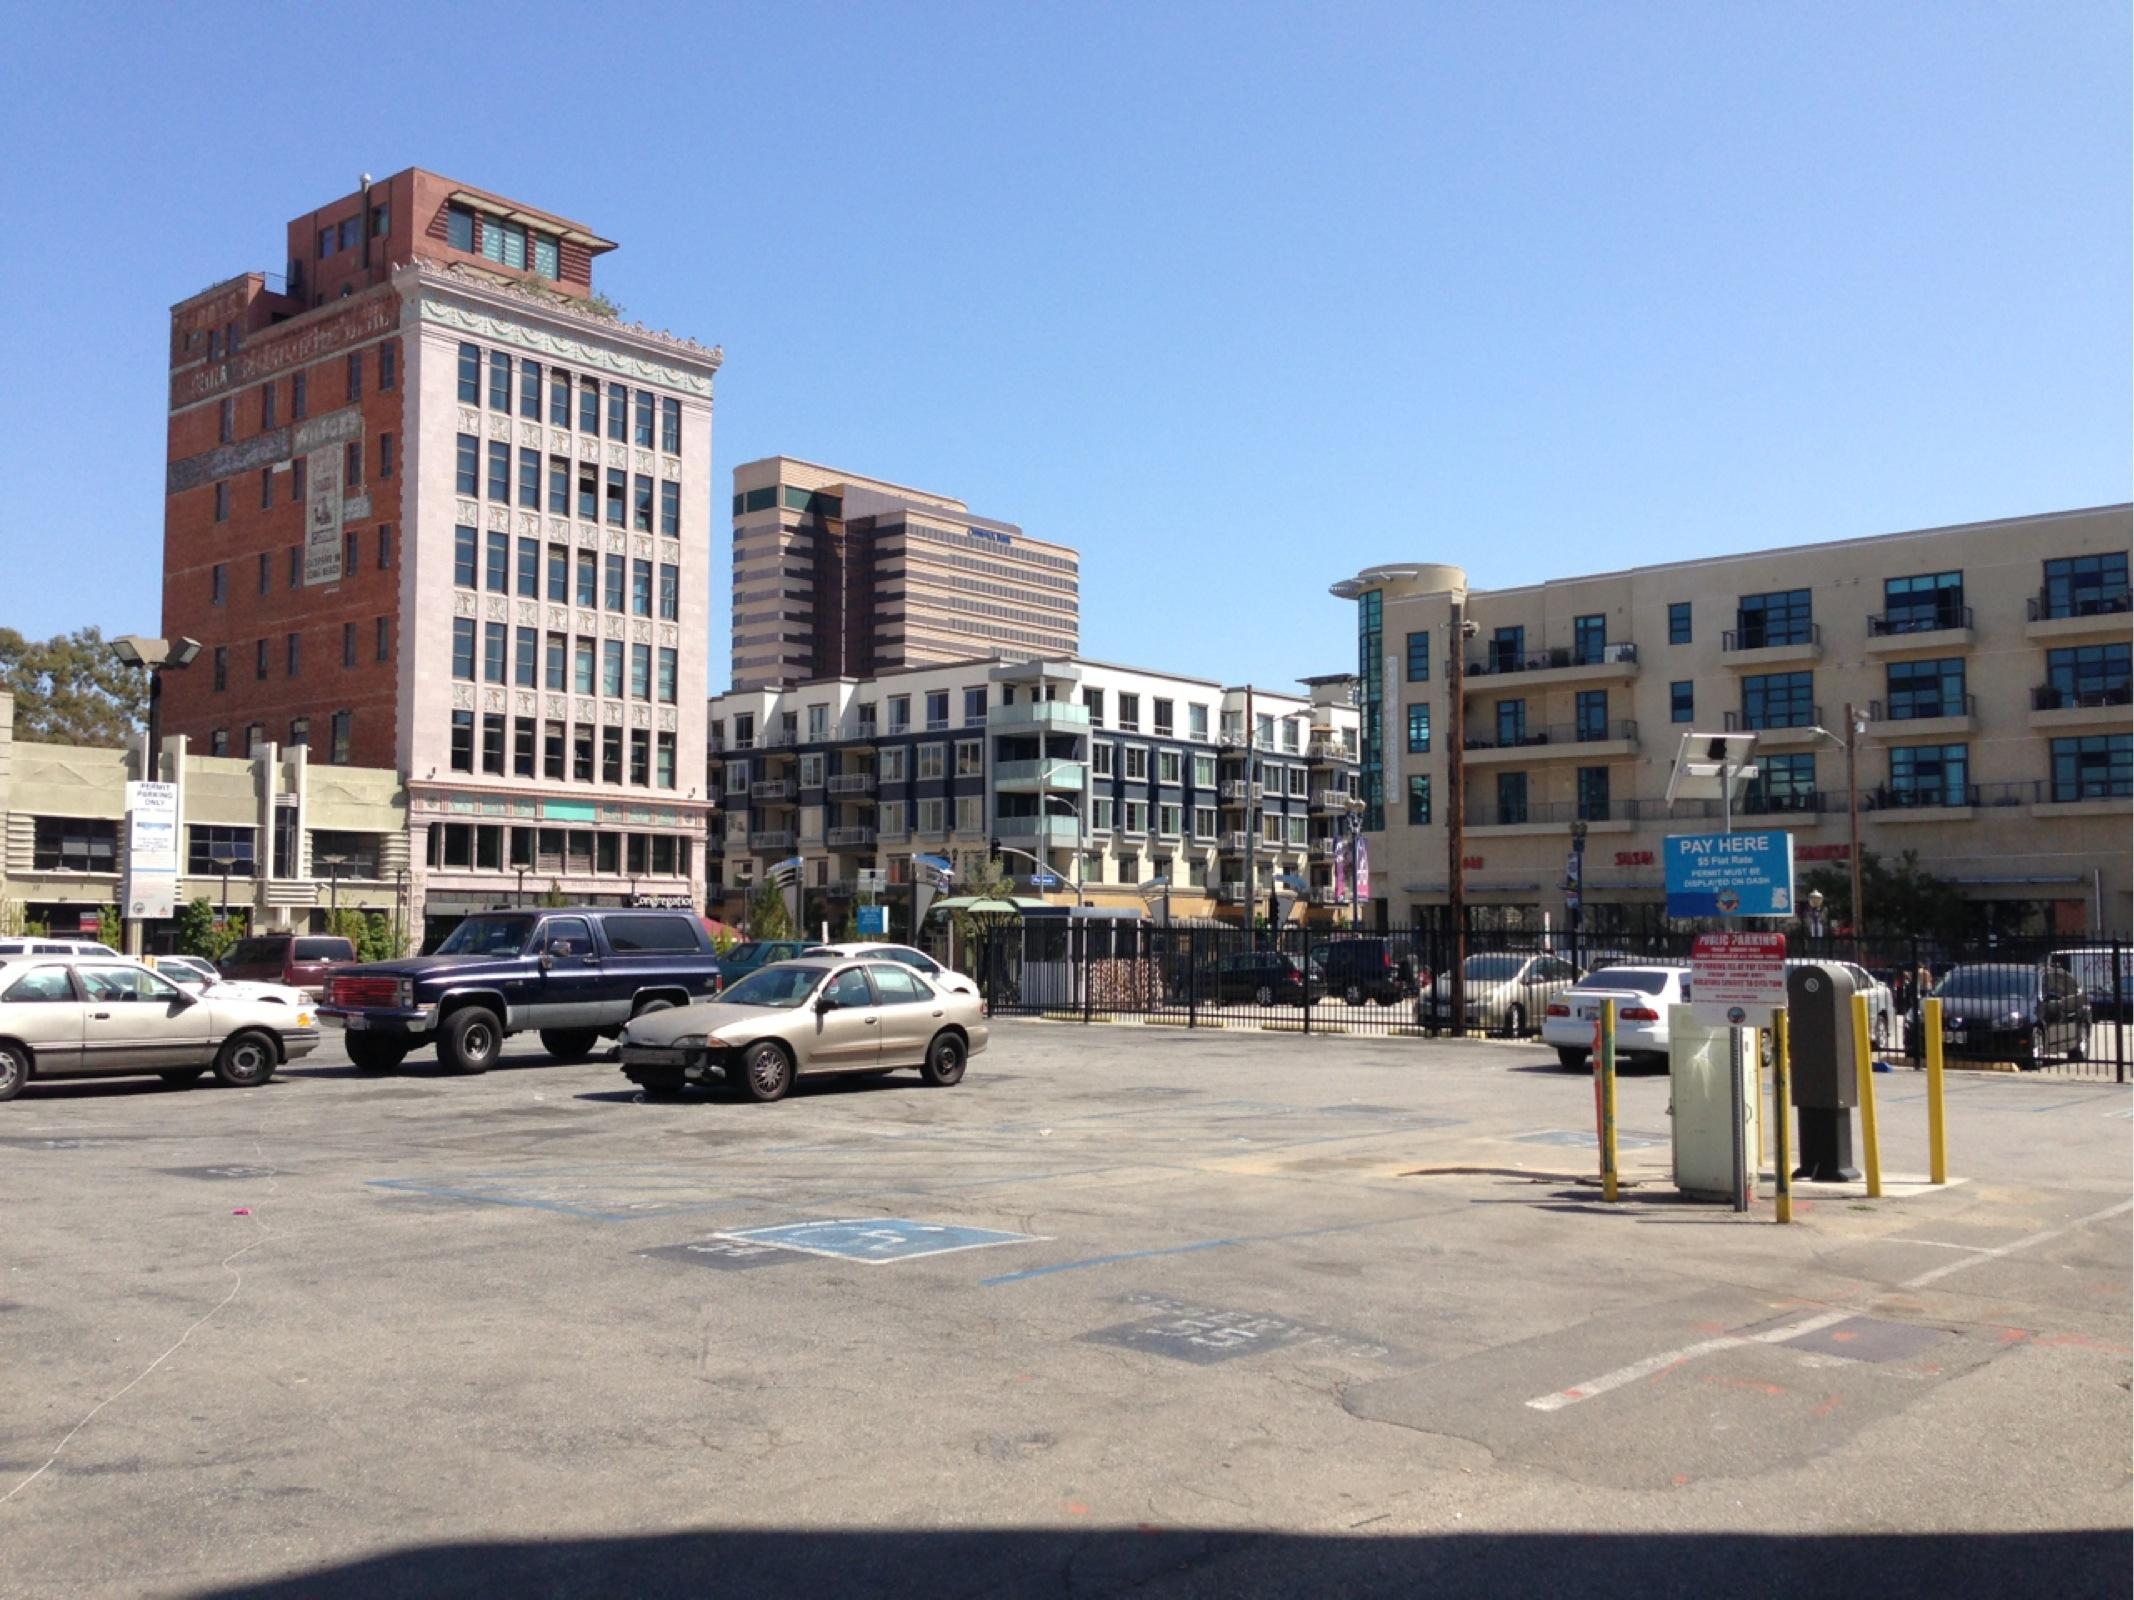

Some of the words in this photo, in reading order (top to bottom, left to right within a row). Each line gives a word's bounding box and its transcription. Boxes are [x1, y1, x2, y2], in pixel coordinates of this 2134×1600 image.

[141, 783, 171, 791] PERMIT
[136, 791, 173, 799] PARKING
[1680, 839, 1713, 855] PAY
[1719, 836, 1769, 852] HERE
[1697, 856, 1709, 866] $5
[1711, 856, 1729, 865] Flat
[1731, 855, 1754, 864] Rate
[1691, 869, 1720, 877] PERMIT
[1723, 868, 1747, 877] MUST
[1749, 867, 1761, 876] BE
[1684, 878, 1730, 888] DISPLAYED
[1731, 878, 1744, 886] ON
[1746, 876, 1771, 885] DASH
[1698, 935, 1729, 946] PUBLIC
[1731, 933, 1778, 946] PARKING
